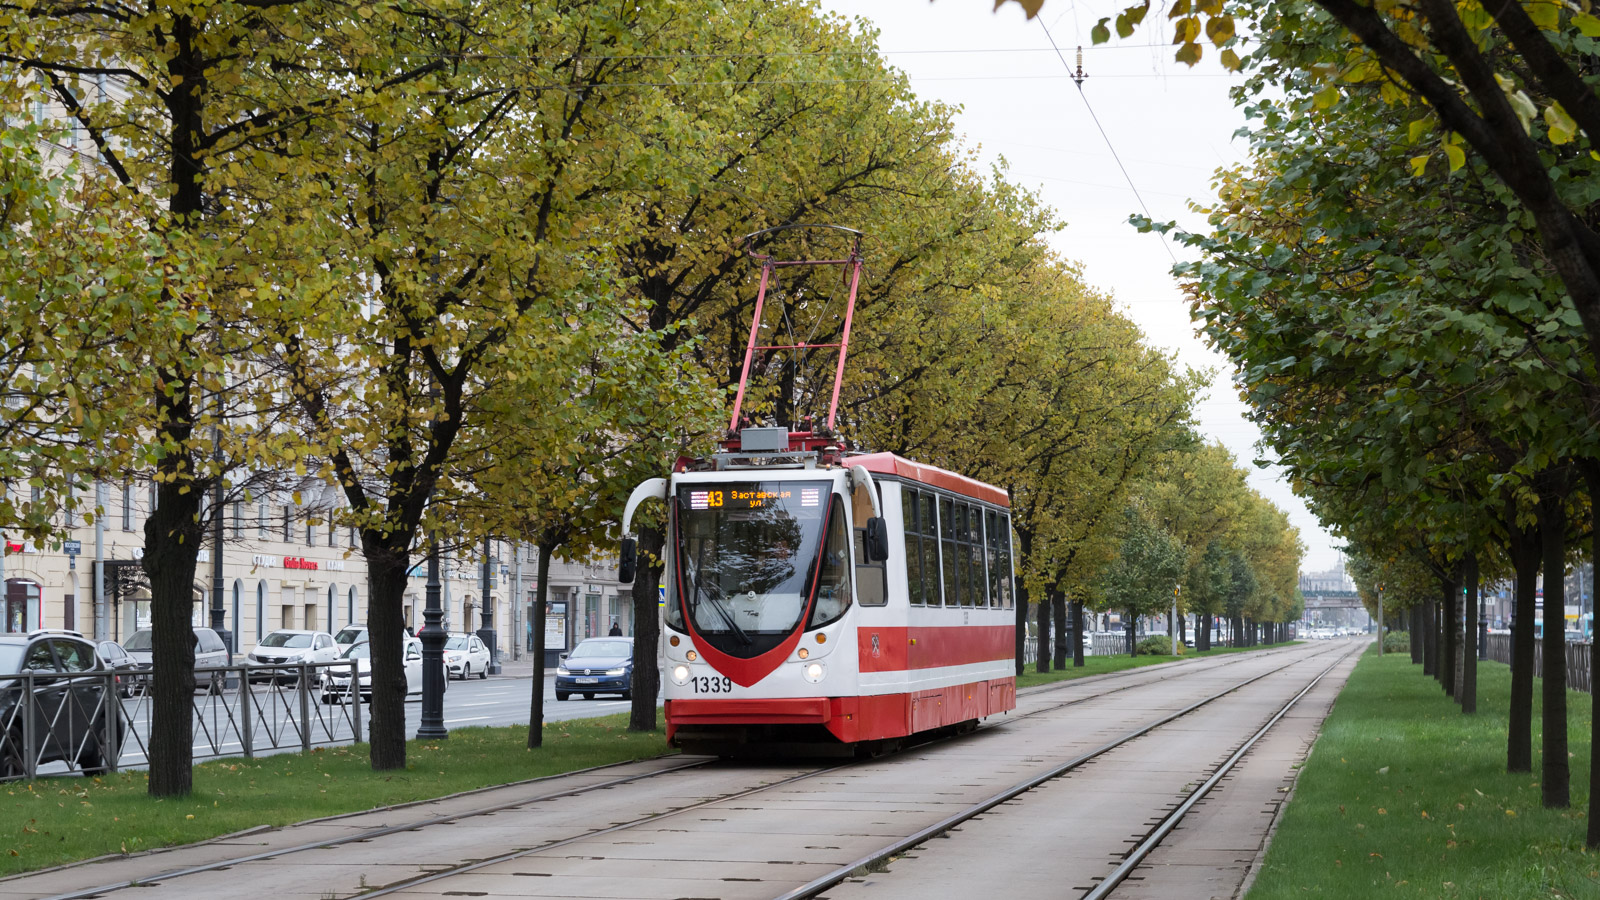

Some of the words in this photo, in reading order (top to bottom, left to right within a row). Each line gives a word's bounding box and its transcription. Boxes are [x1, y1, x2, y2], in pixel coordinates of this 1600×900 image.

[707, 491, 723, 507] 43
[731, 490, 791, 499] Заставская
[749, 499, 765, 508] ул.
[691, 676, 732, 694] 1339
